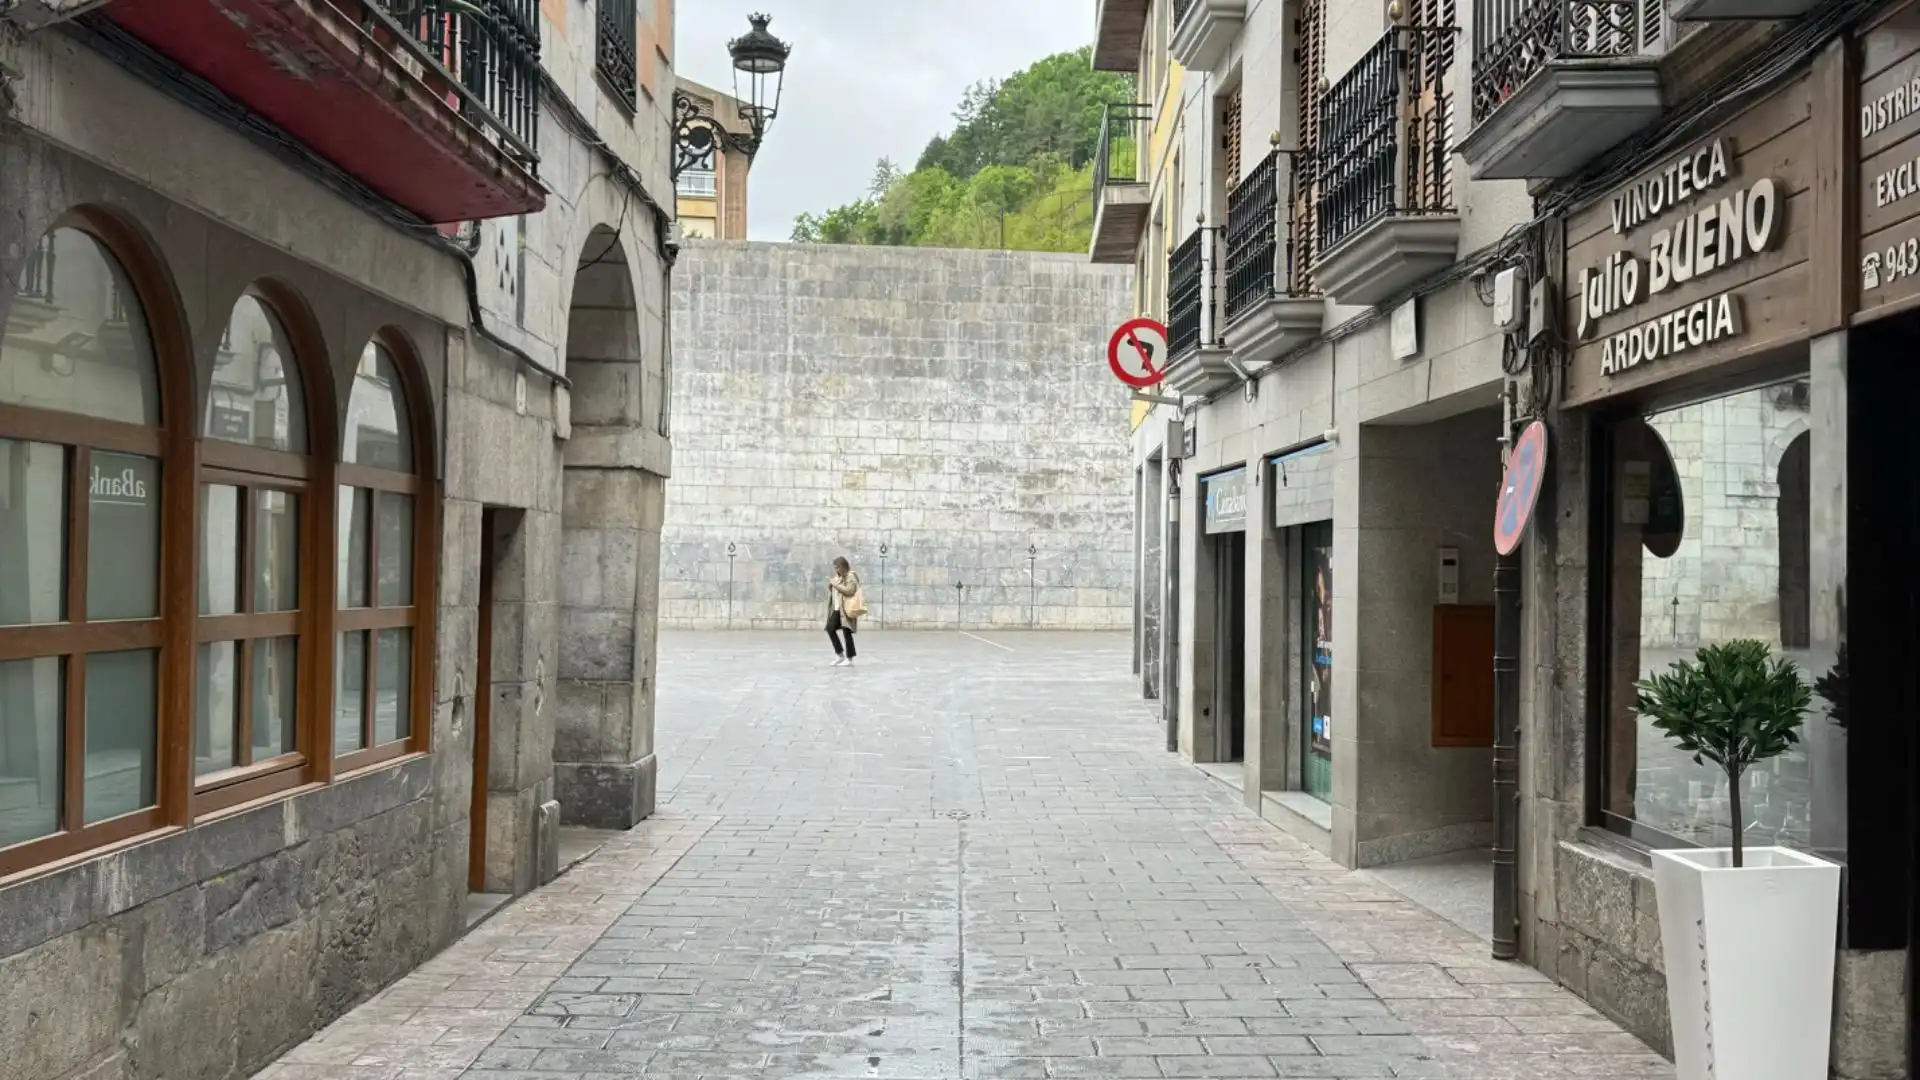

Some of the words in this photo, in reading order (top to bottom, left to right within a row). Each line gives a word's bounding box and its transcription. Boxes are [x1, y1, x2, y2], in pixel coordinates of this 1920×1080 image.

[1611, 138, 1728, 235] VINOTECA
[1577, 251, 1639, 341] Julio
[1649, 177, 1776, 295] BUENO
[1886, 237, 1919, 282] 943
[1600, 293, 1735, 378] ARDOTEGIA
